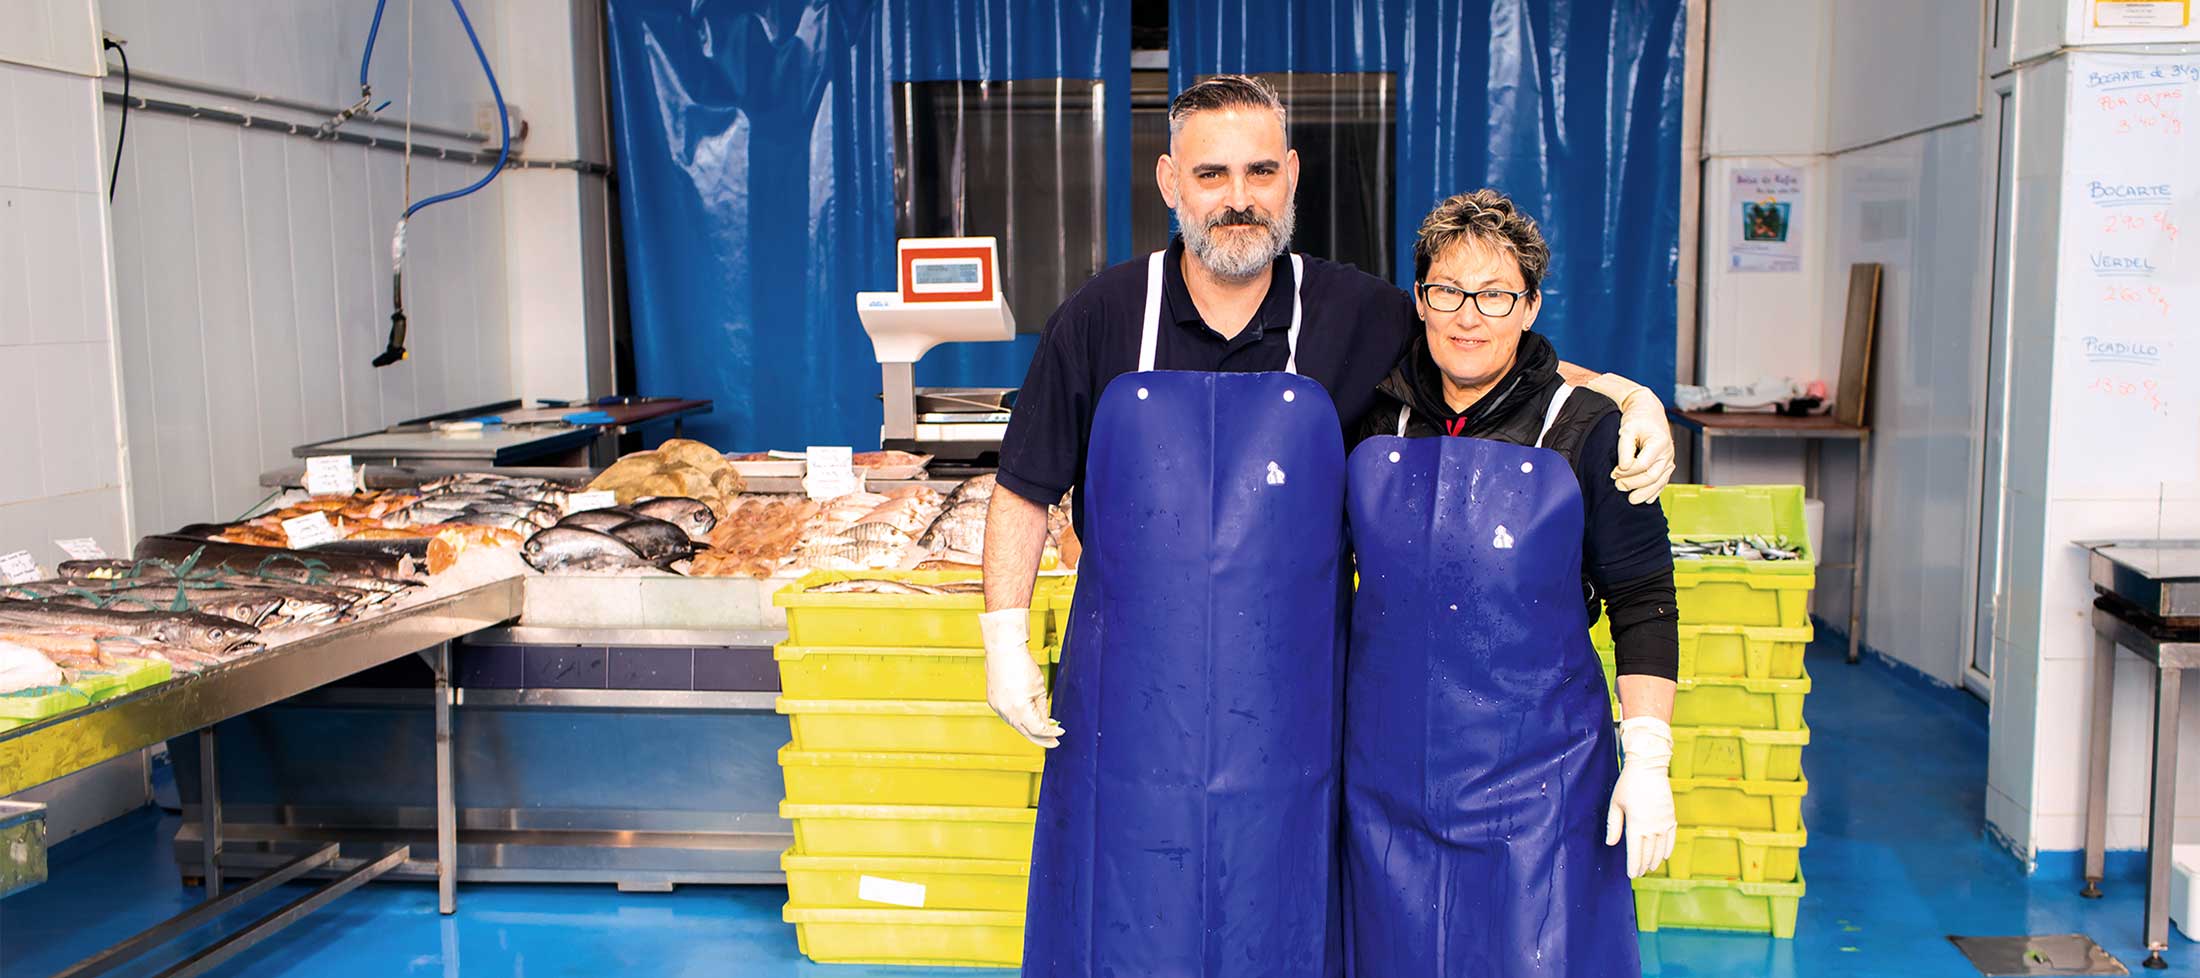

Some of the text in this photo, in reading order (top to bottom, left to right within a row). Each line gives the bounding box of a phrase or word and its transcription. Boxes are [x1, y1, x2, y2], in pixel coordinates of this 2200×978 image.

[2087, 71, 2145, 86] BOCARTE
[2089, 181, 2171, 198] BOCARTE
[2089, 251, 2157, 269] VERDEL
